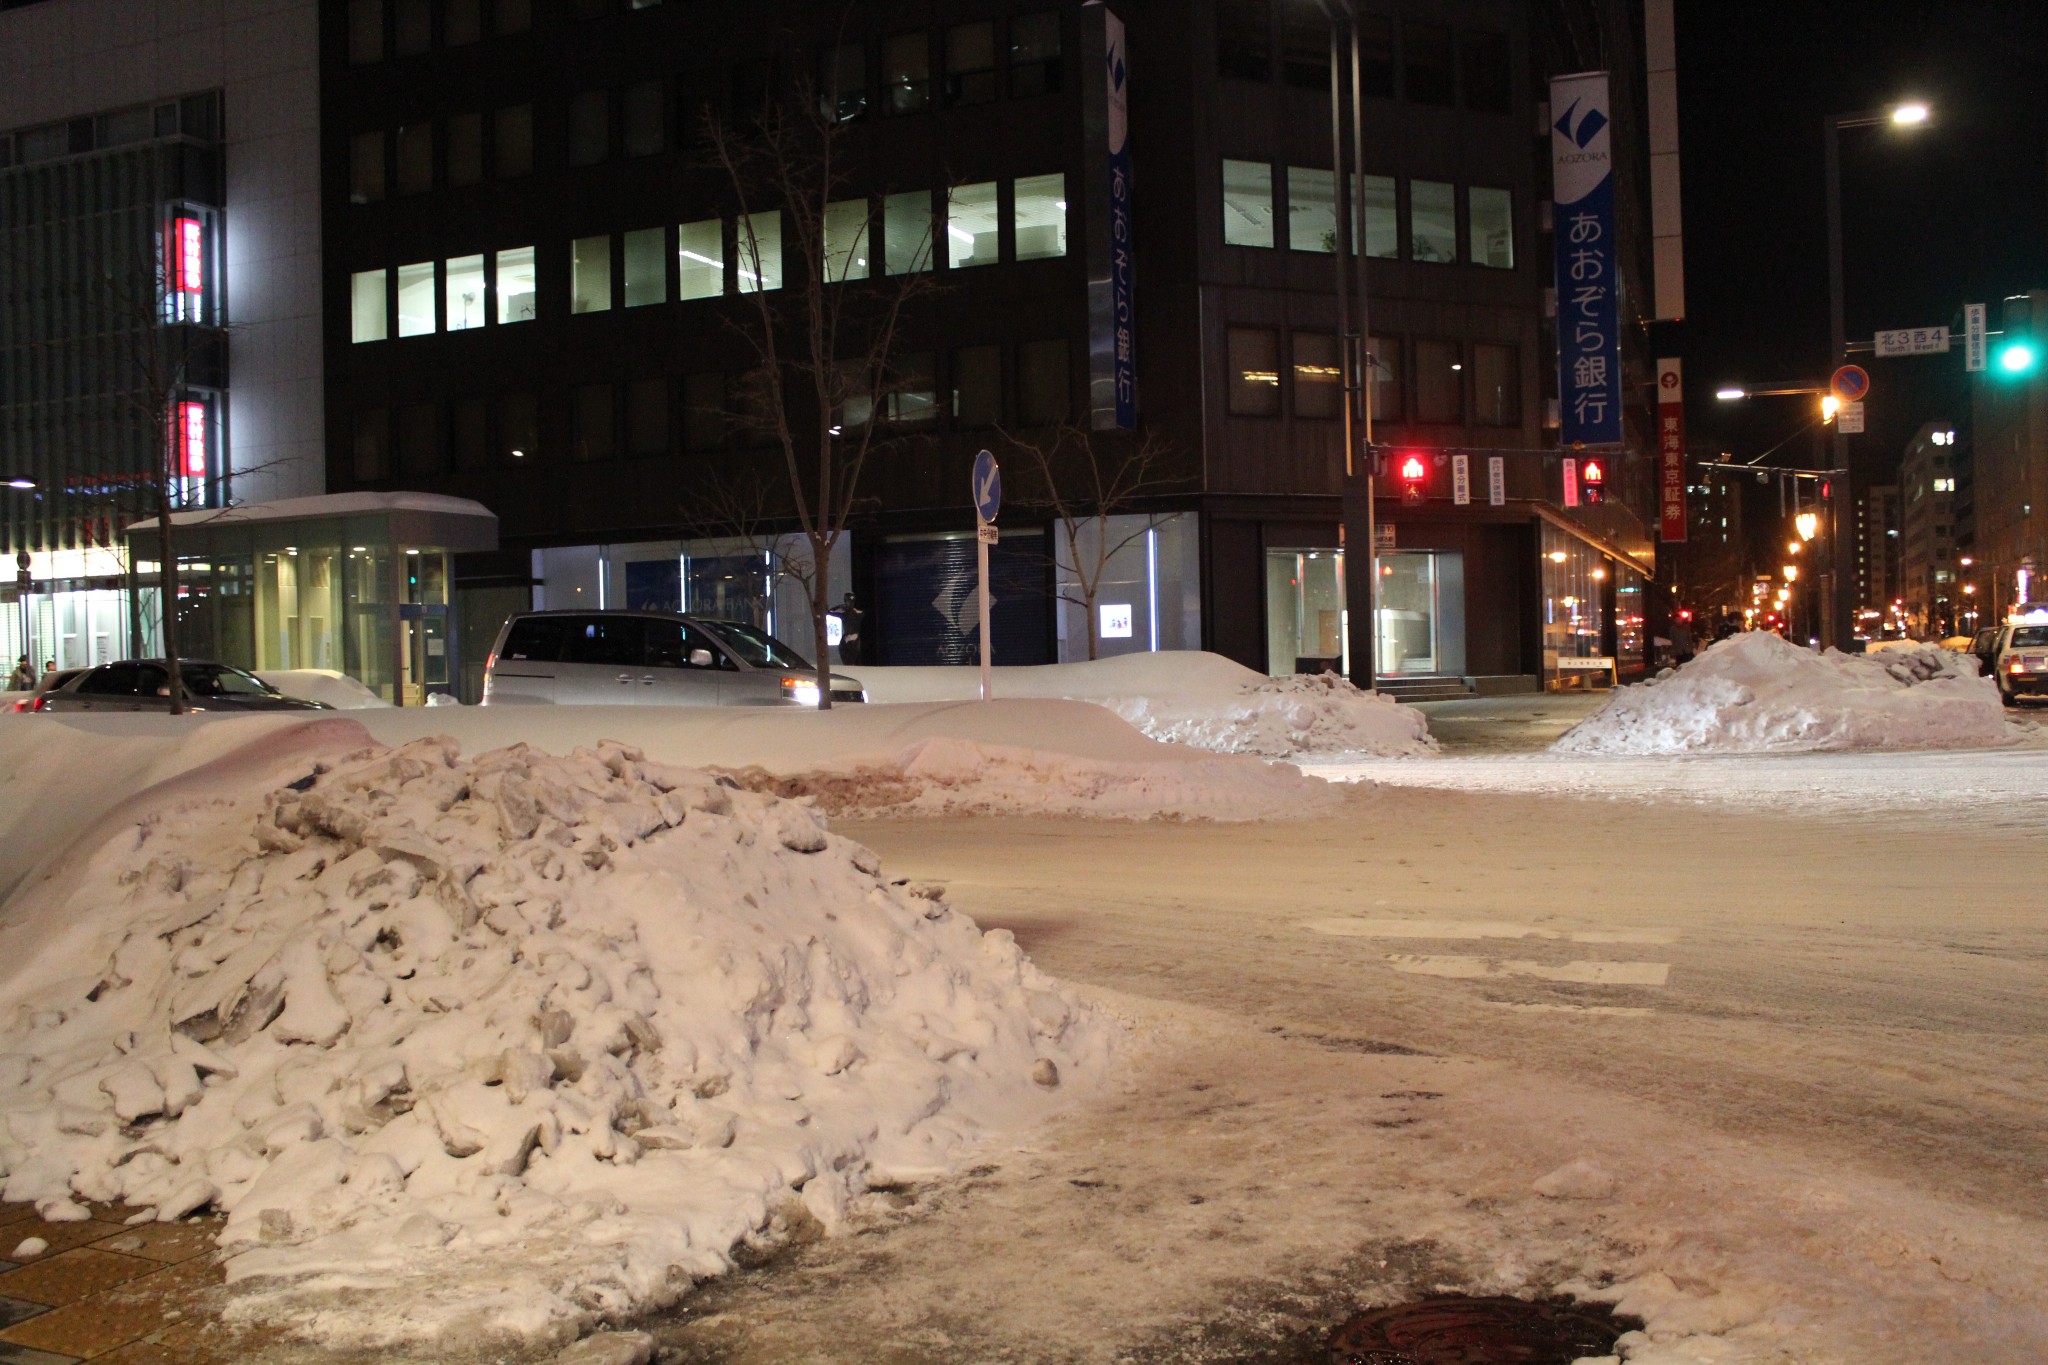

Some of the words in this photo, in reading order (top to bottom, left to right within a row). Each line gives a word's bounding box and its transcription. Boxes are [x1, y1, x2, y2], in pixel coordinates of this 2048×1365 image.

[1556, 151, 1608, 165] AOZORA
[1113, 166, 1131, 404] あおぞら銀行
[1570, 212, 1608, 425] あおぞら銀行
[1664, 416, 1681, 521] 東海東京証券
